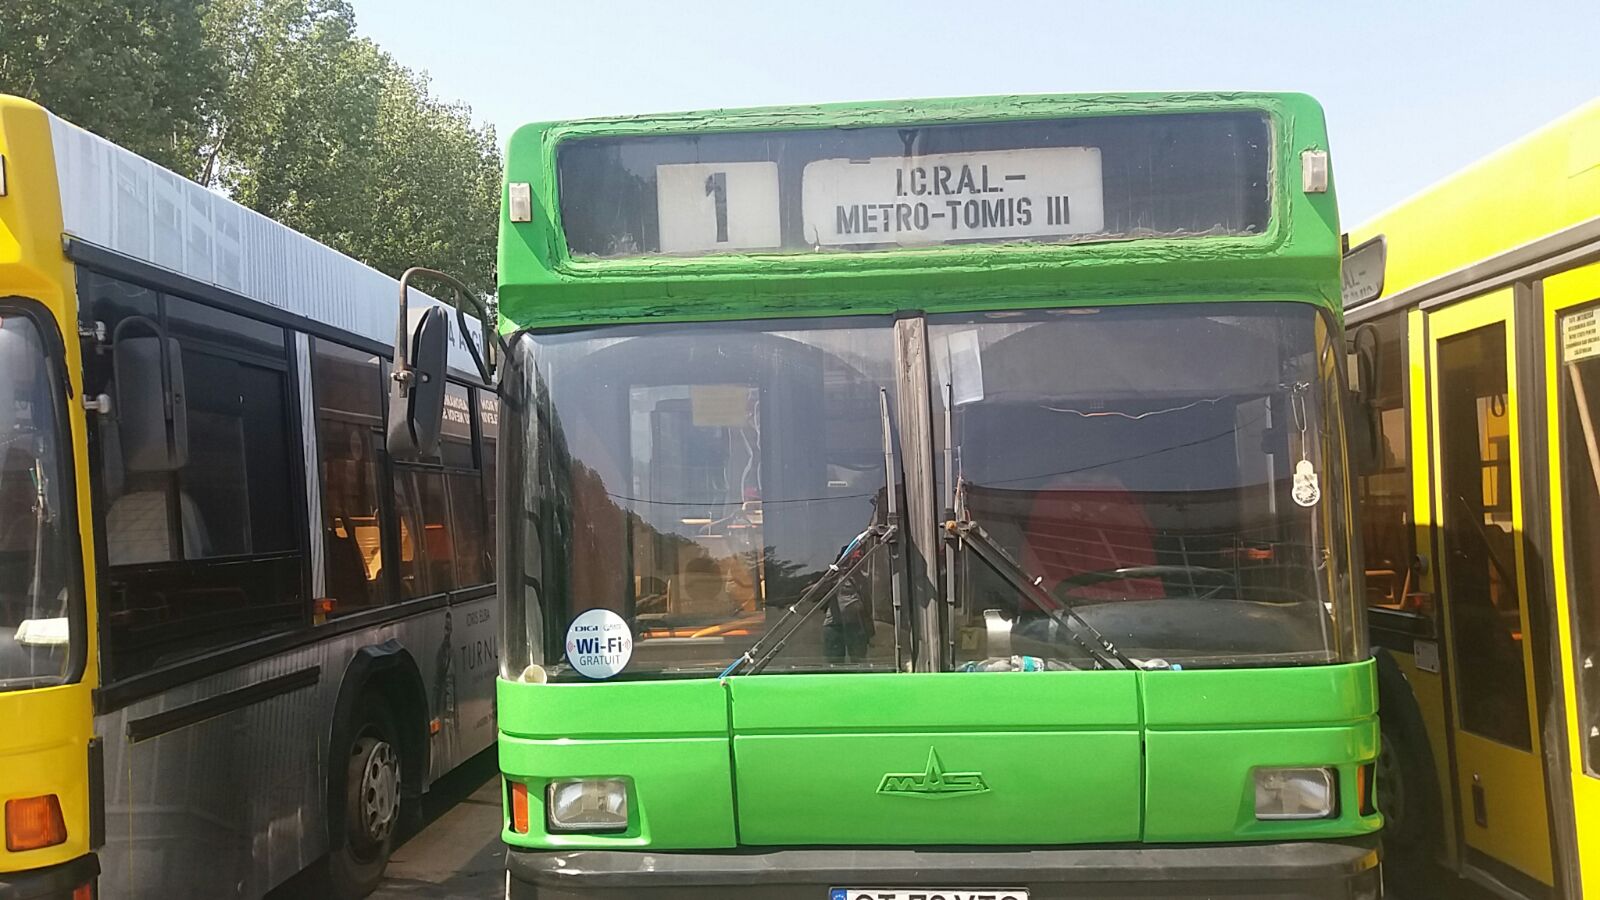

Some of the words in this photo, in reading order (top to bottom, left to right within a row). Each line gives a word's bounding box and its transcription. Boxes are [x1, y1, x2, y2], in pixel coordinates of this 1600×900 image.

[705, 172, 729, 243] 1
[836, 197, 1032, 234] METRO-TOMIS
[1047, 196, 1070, 226] III
[576, 637, 622, 654] Wi-Fi
[580, 655, 620, 665] GRATUIT
